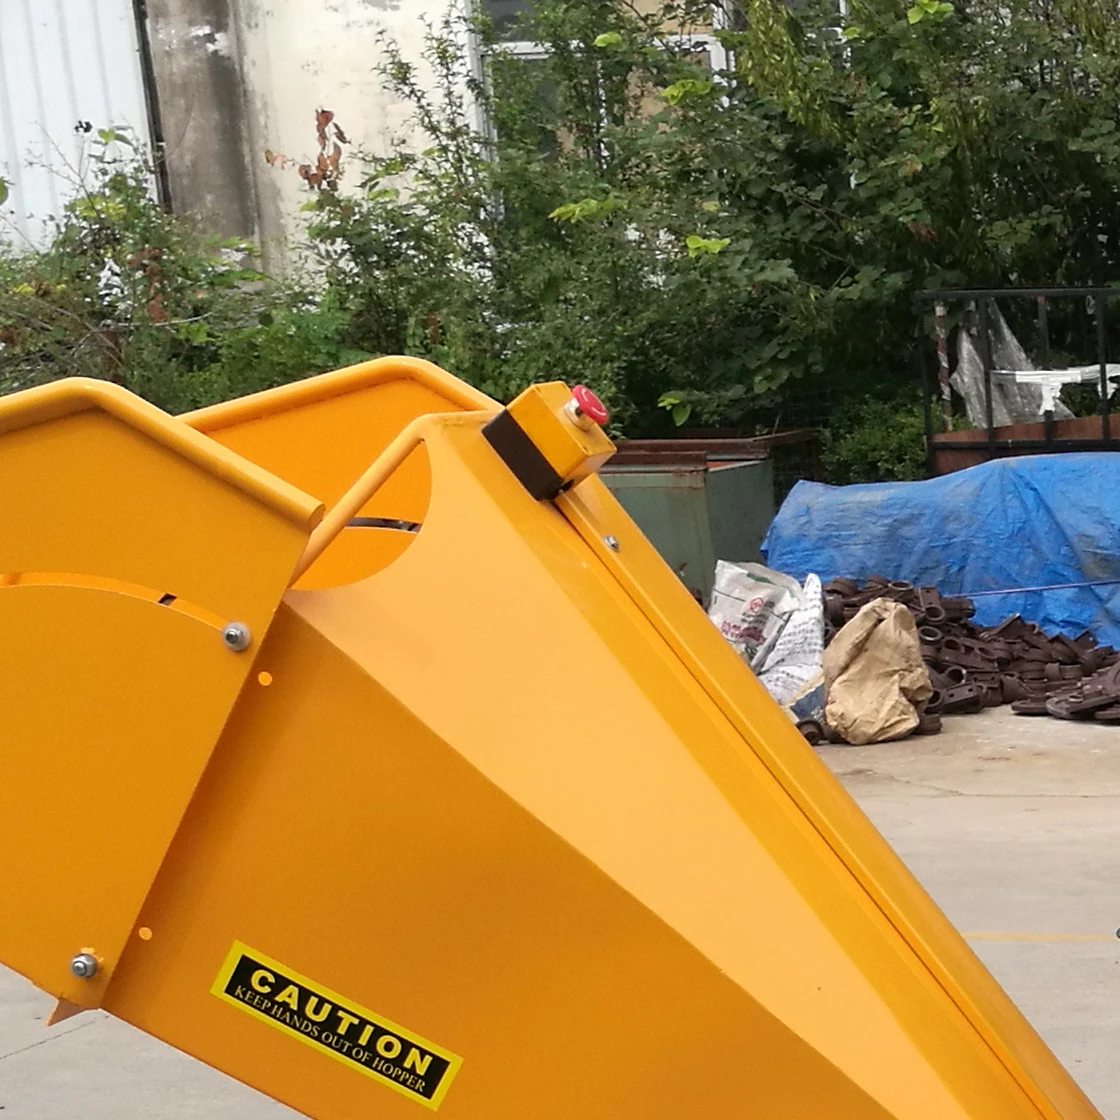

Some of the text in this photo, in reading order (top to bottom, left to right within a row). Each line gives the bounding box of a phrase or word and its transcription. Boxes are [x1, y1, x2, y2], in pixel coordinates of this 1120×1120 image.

[234, 985, 426, 1093] KEEP HANDS OUT OF HOPPER
[250, 969, 433, 1076] CAUTION
